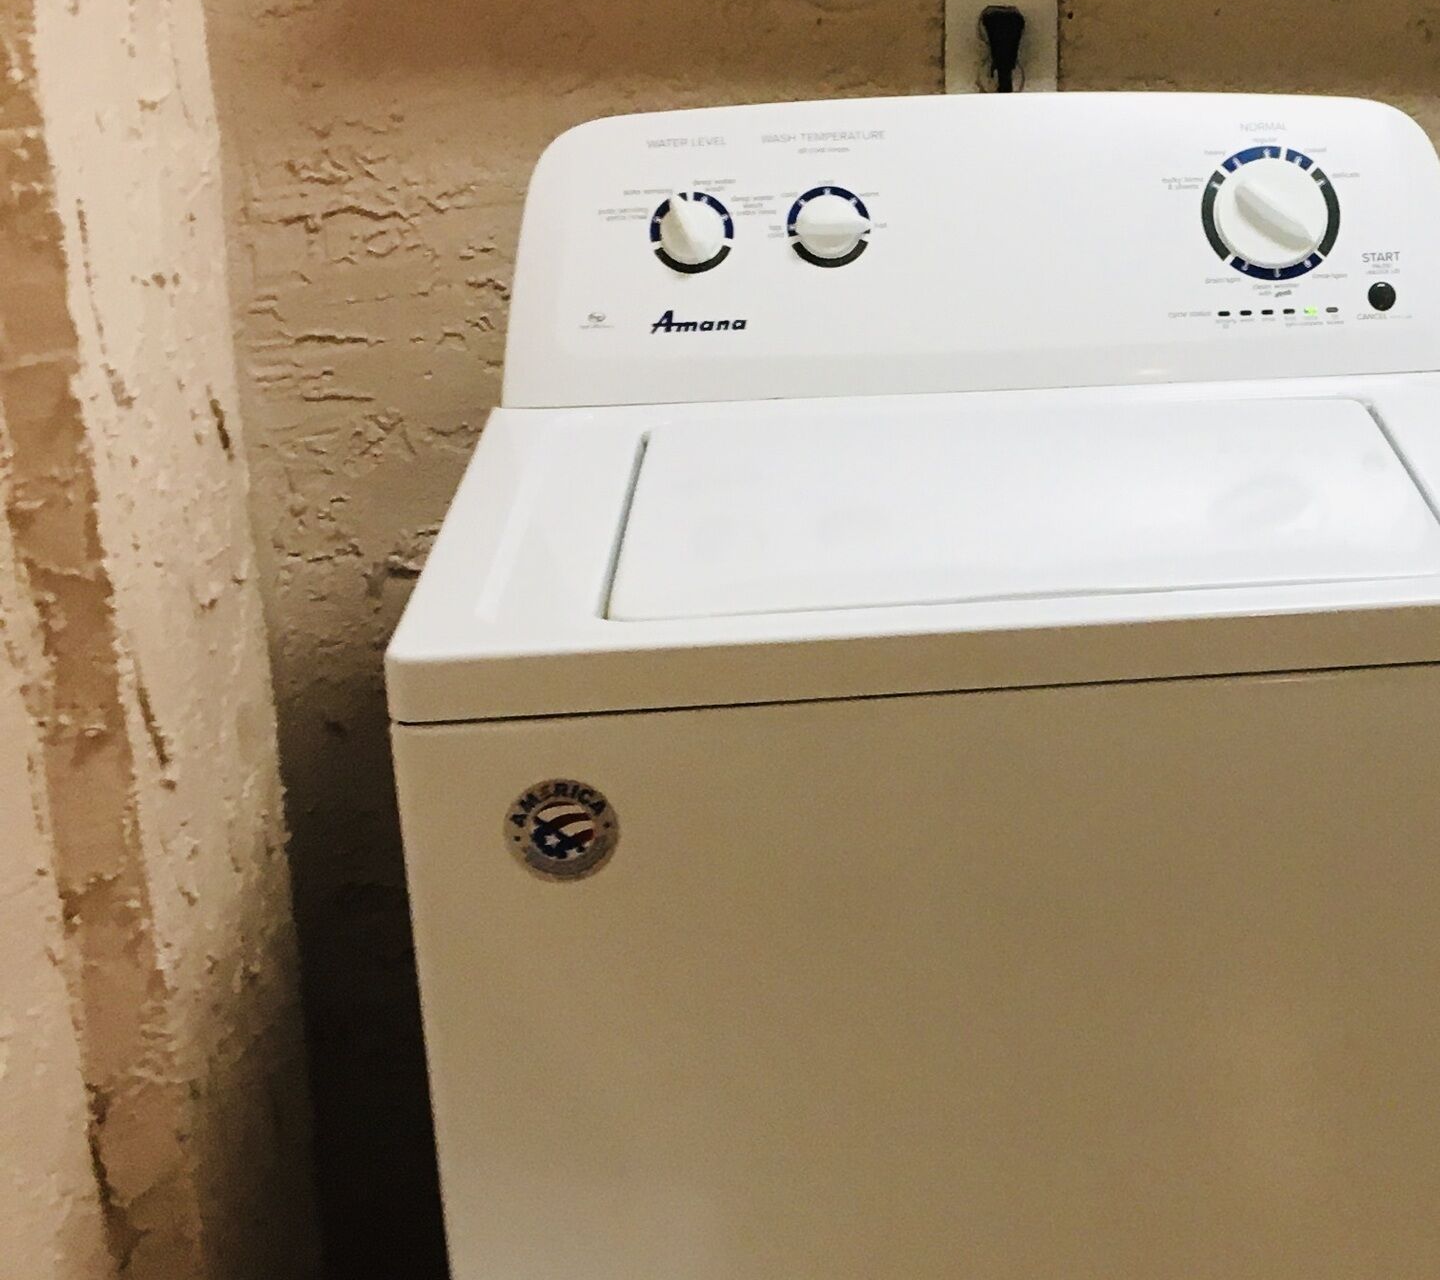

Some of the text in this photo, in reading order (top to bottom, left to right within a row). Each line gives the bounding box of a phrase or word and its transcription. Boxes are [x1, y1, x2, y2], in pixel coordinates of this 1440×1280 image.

[1239, 122, 1288, 133] NORMAL
[691, 135, 728, 147] LEVEL
[799, 129, 887, 142] TEMPERATURE
[1361, 251, 1401, 263] START
[651, 309, 747, 335] Amana
[509, 780, 607, 828] AMERICA
